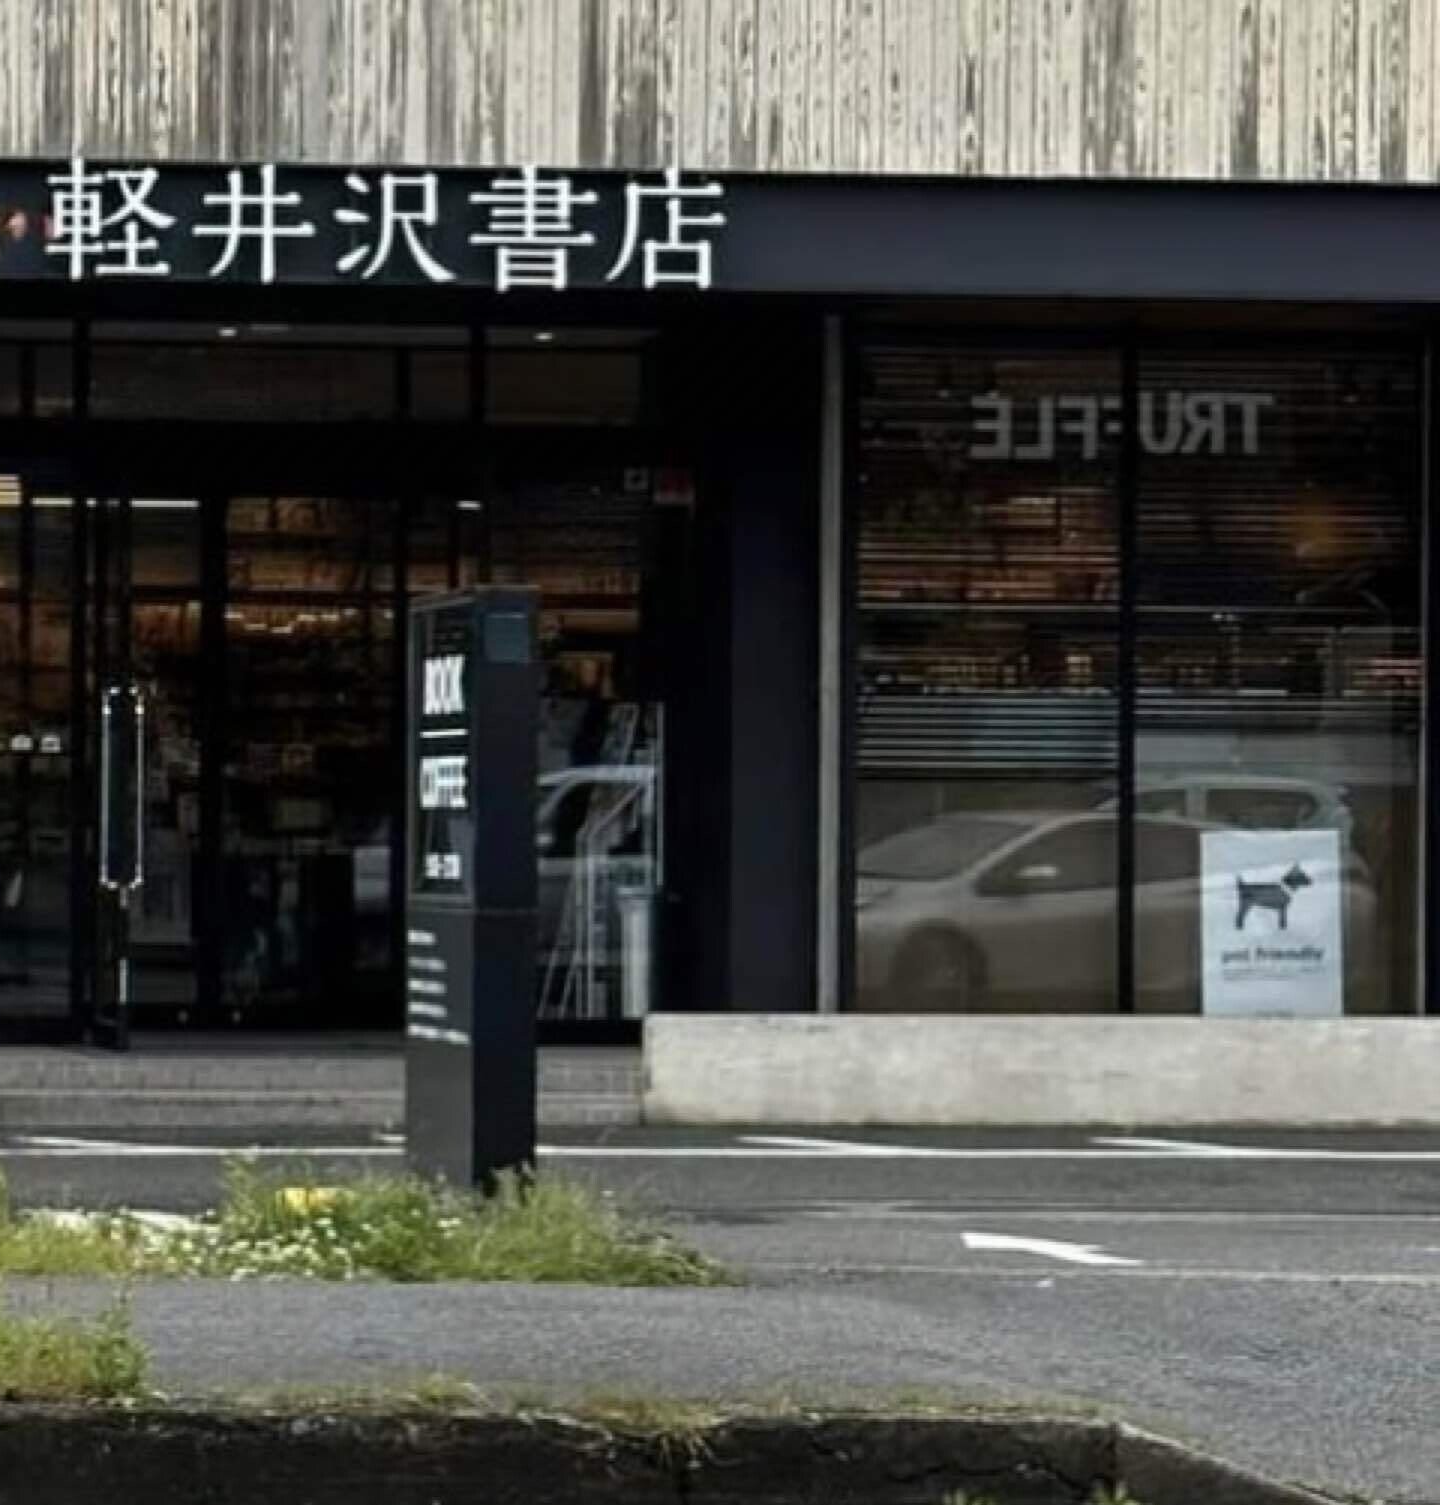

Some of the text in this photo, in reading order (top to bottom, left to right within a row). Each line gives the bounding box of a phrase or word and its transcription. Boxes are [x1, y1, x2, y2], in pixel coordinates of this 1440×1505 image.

[45, 156, 727, 290] 軽井沢書店
[423, 655, 465, 715] BOOK
[420, 755, 468, 809] COFFEE
